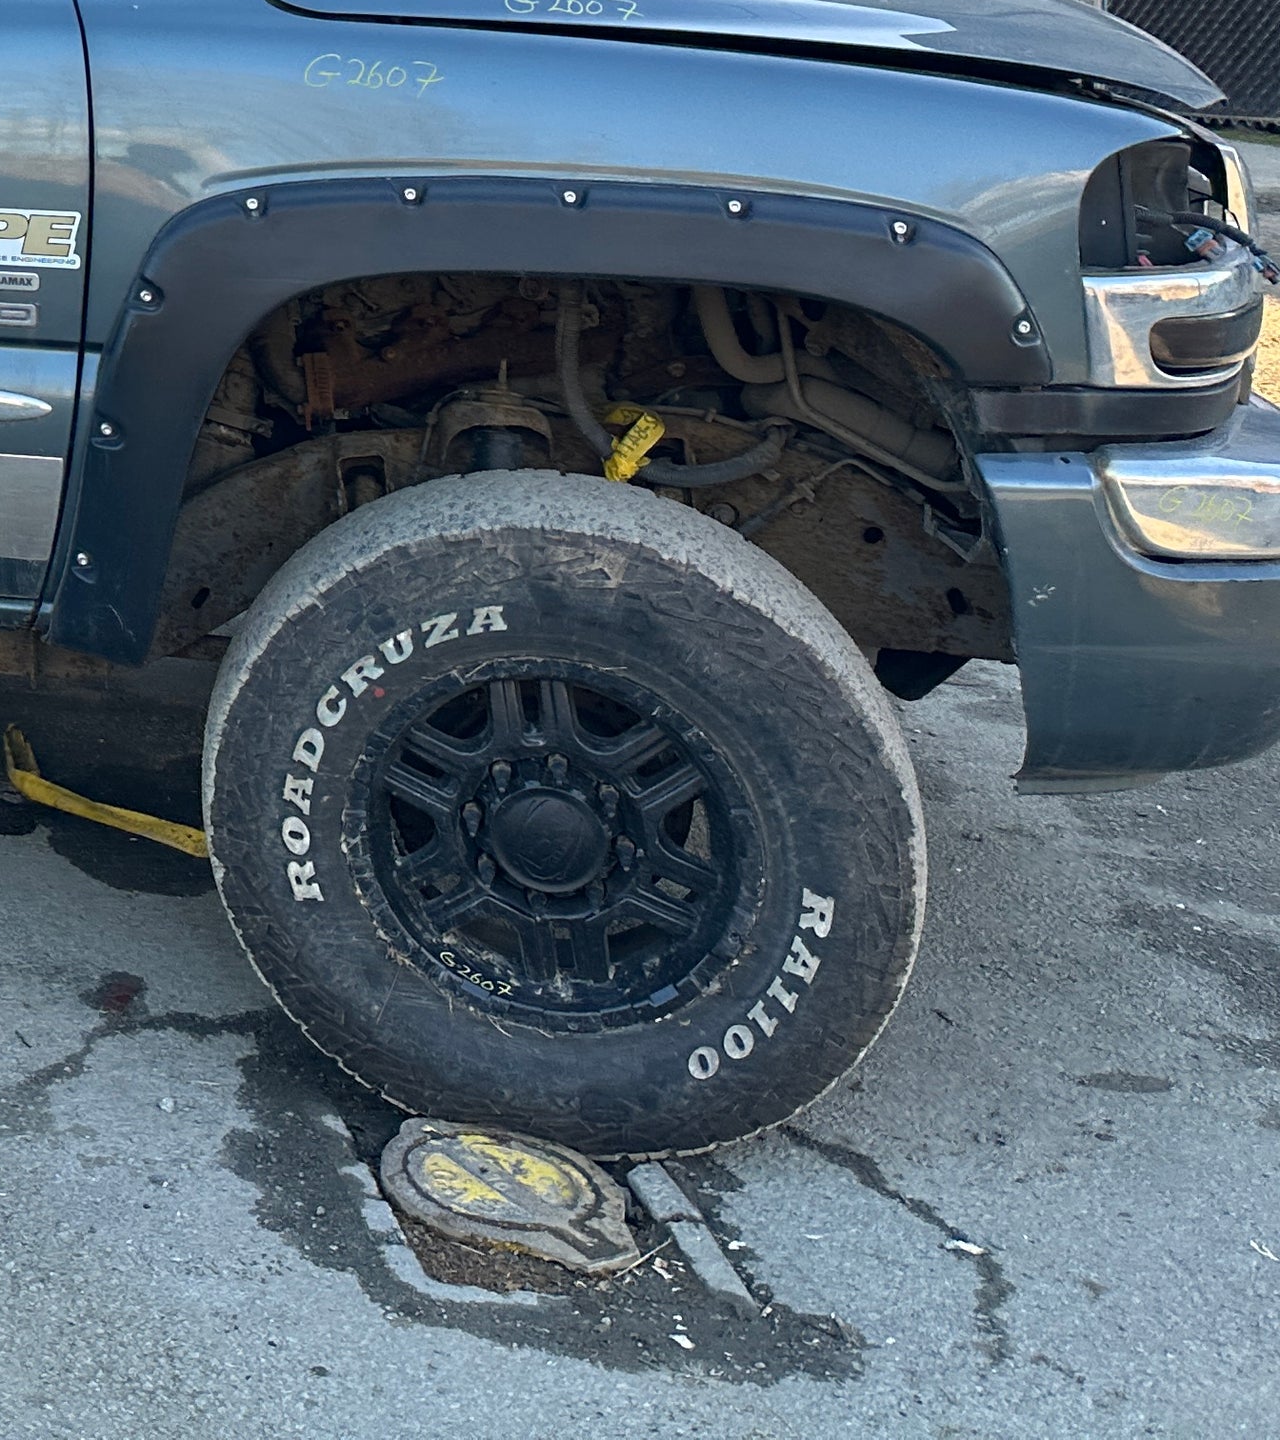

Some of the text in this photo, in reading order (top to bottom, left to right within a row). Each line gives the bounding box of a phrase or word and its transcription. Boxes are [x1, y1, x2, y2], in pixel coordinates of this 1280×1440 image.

[303, 53, 445, 98] G2607
[281, 604, 509, 903] ROADCRUZA
[440, 951, 515, 997] G2607
